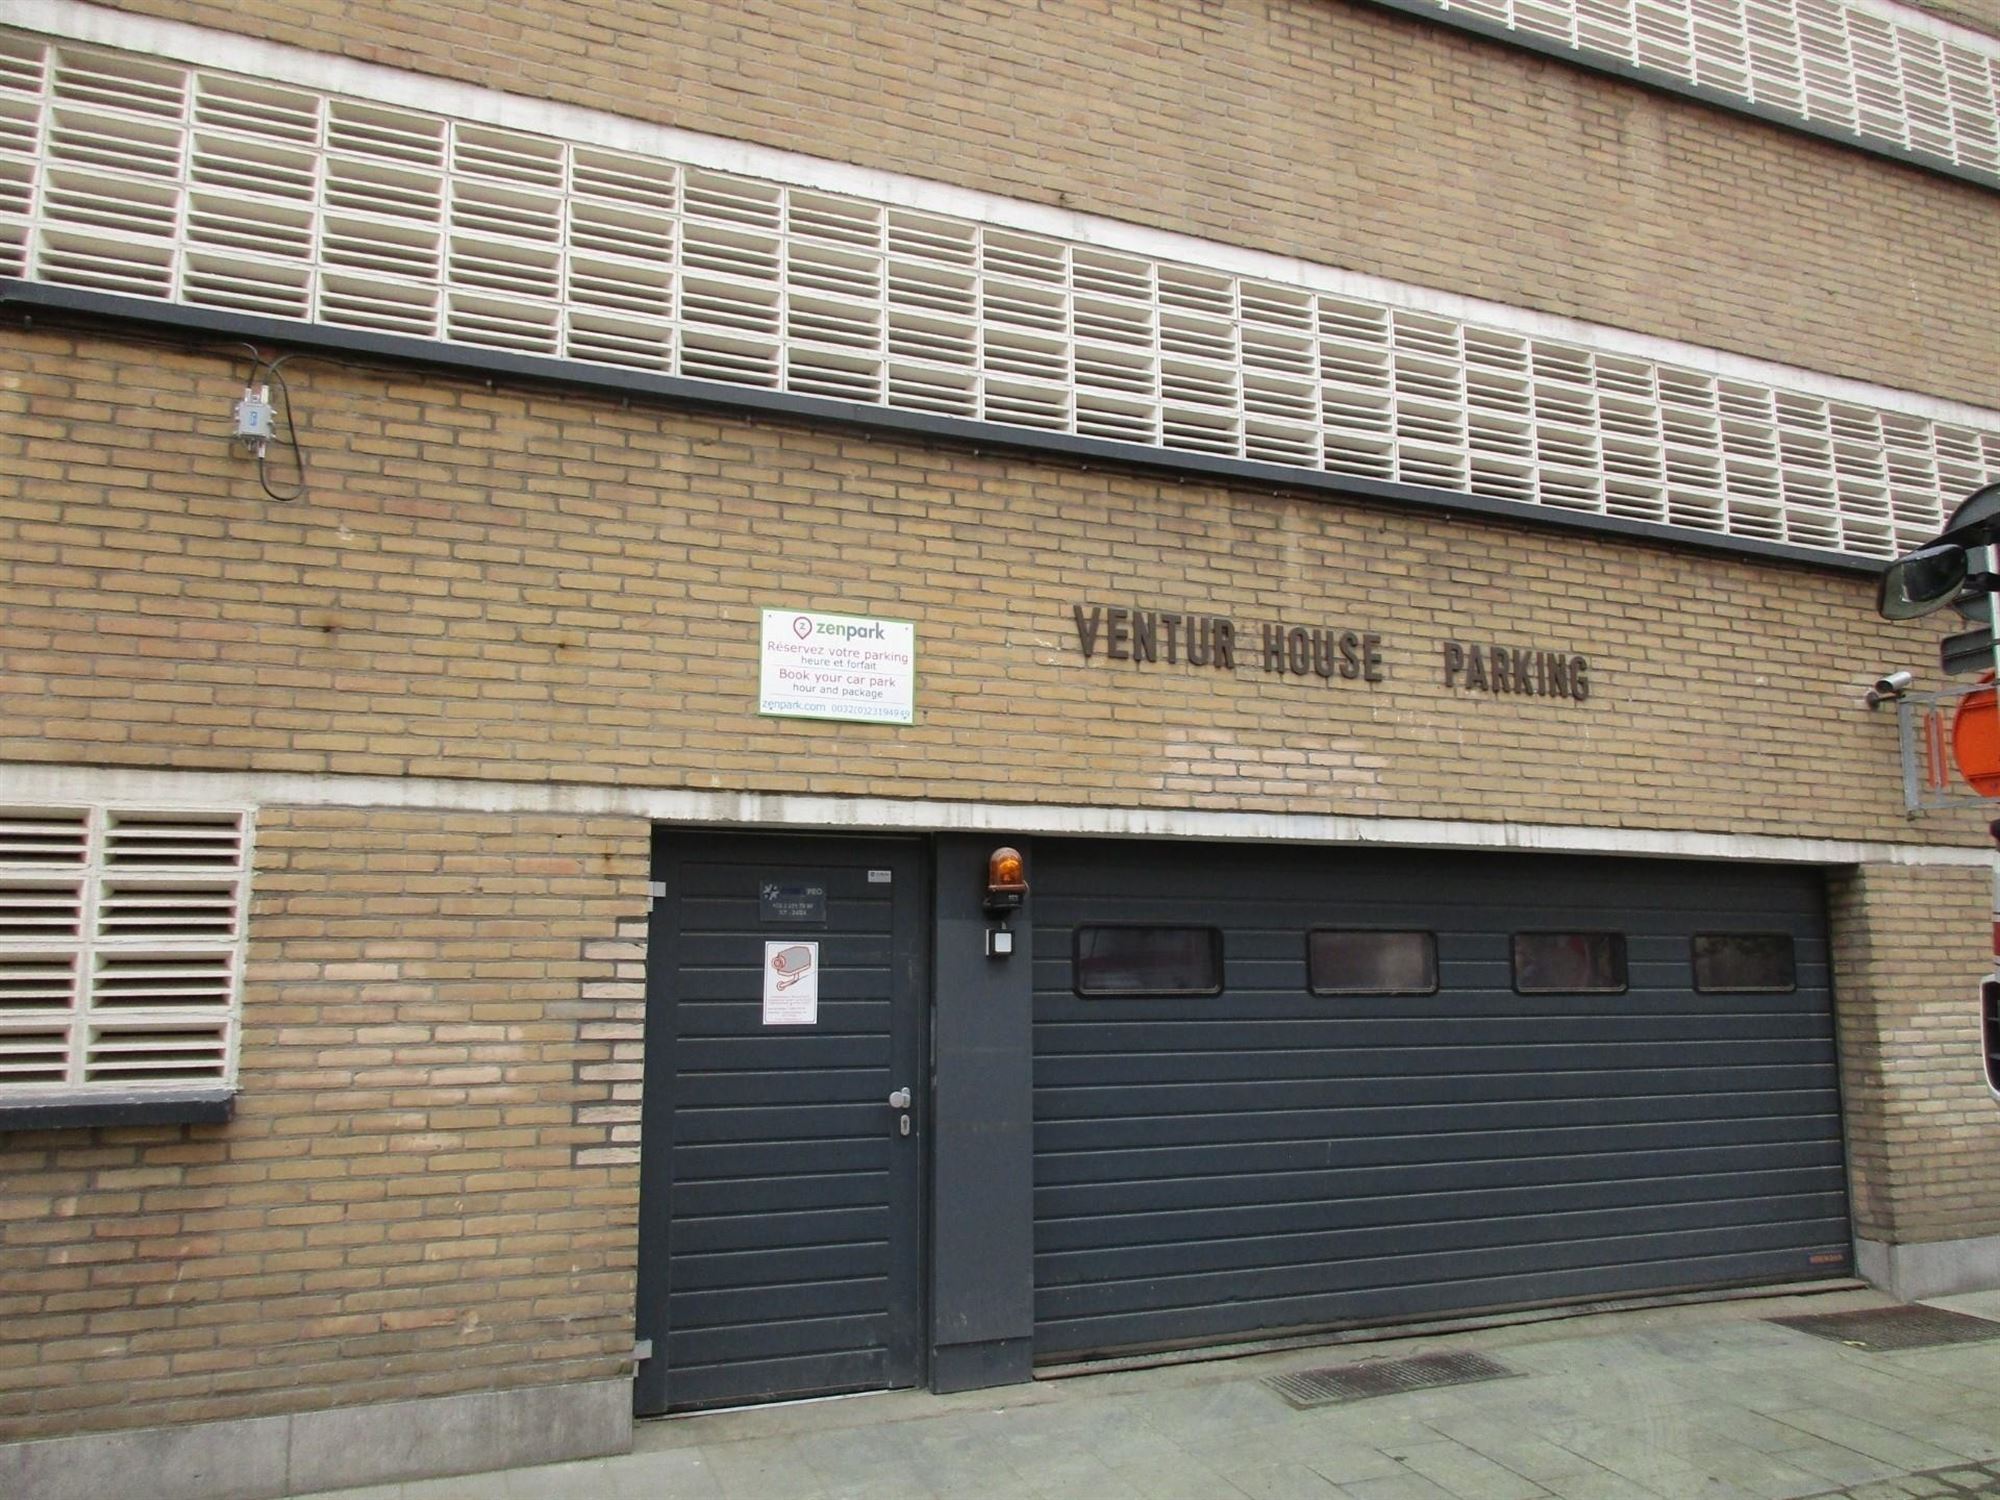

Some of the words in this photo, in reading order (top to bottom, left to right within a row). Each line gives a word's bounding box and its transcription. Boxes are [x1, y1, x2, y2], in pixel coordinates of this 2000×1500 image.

[816, 622, 886, 641] zenpark
[829, 647, 861, 658] votre
[864, 651, 909, 664] parking
[1073, 605, 1235, 669] VENTUR
[1263, 623, 1383, 682] HOUSE
[1444, 642, 1589, 700] PARKING
[801, 656, 831, 666] heure
[847, 660, 877, 670] forfait
[779, 668, 810, 680] Book
[814, 674, 843, 684] your
[846, 676, 866, 685] car
[869, 679, 896, 688] park
[793, 683, 816, 693] hour
[820, 685, 839, 695] and
[842, 688, 883, 699] package
[762, 700, 826, 711] zenpark.com
